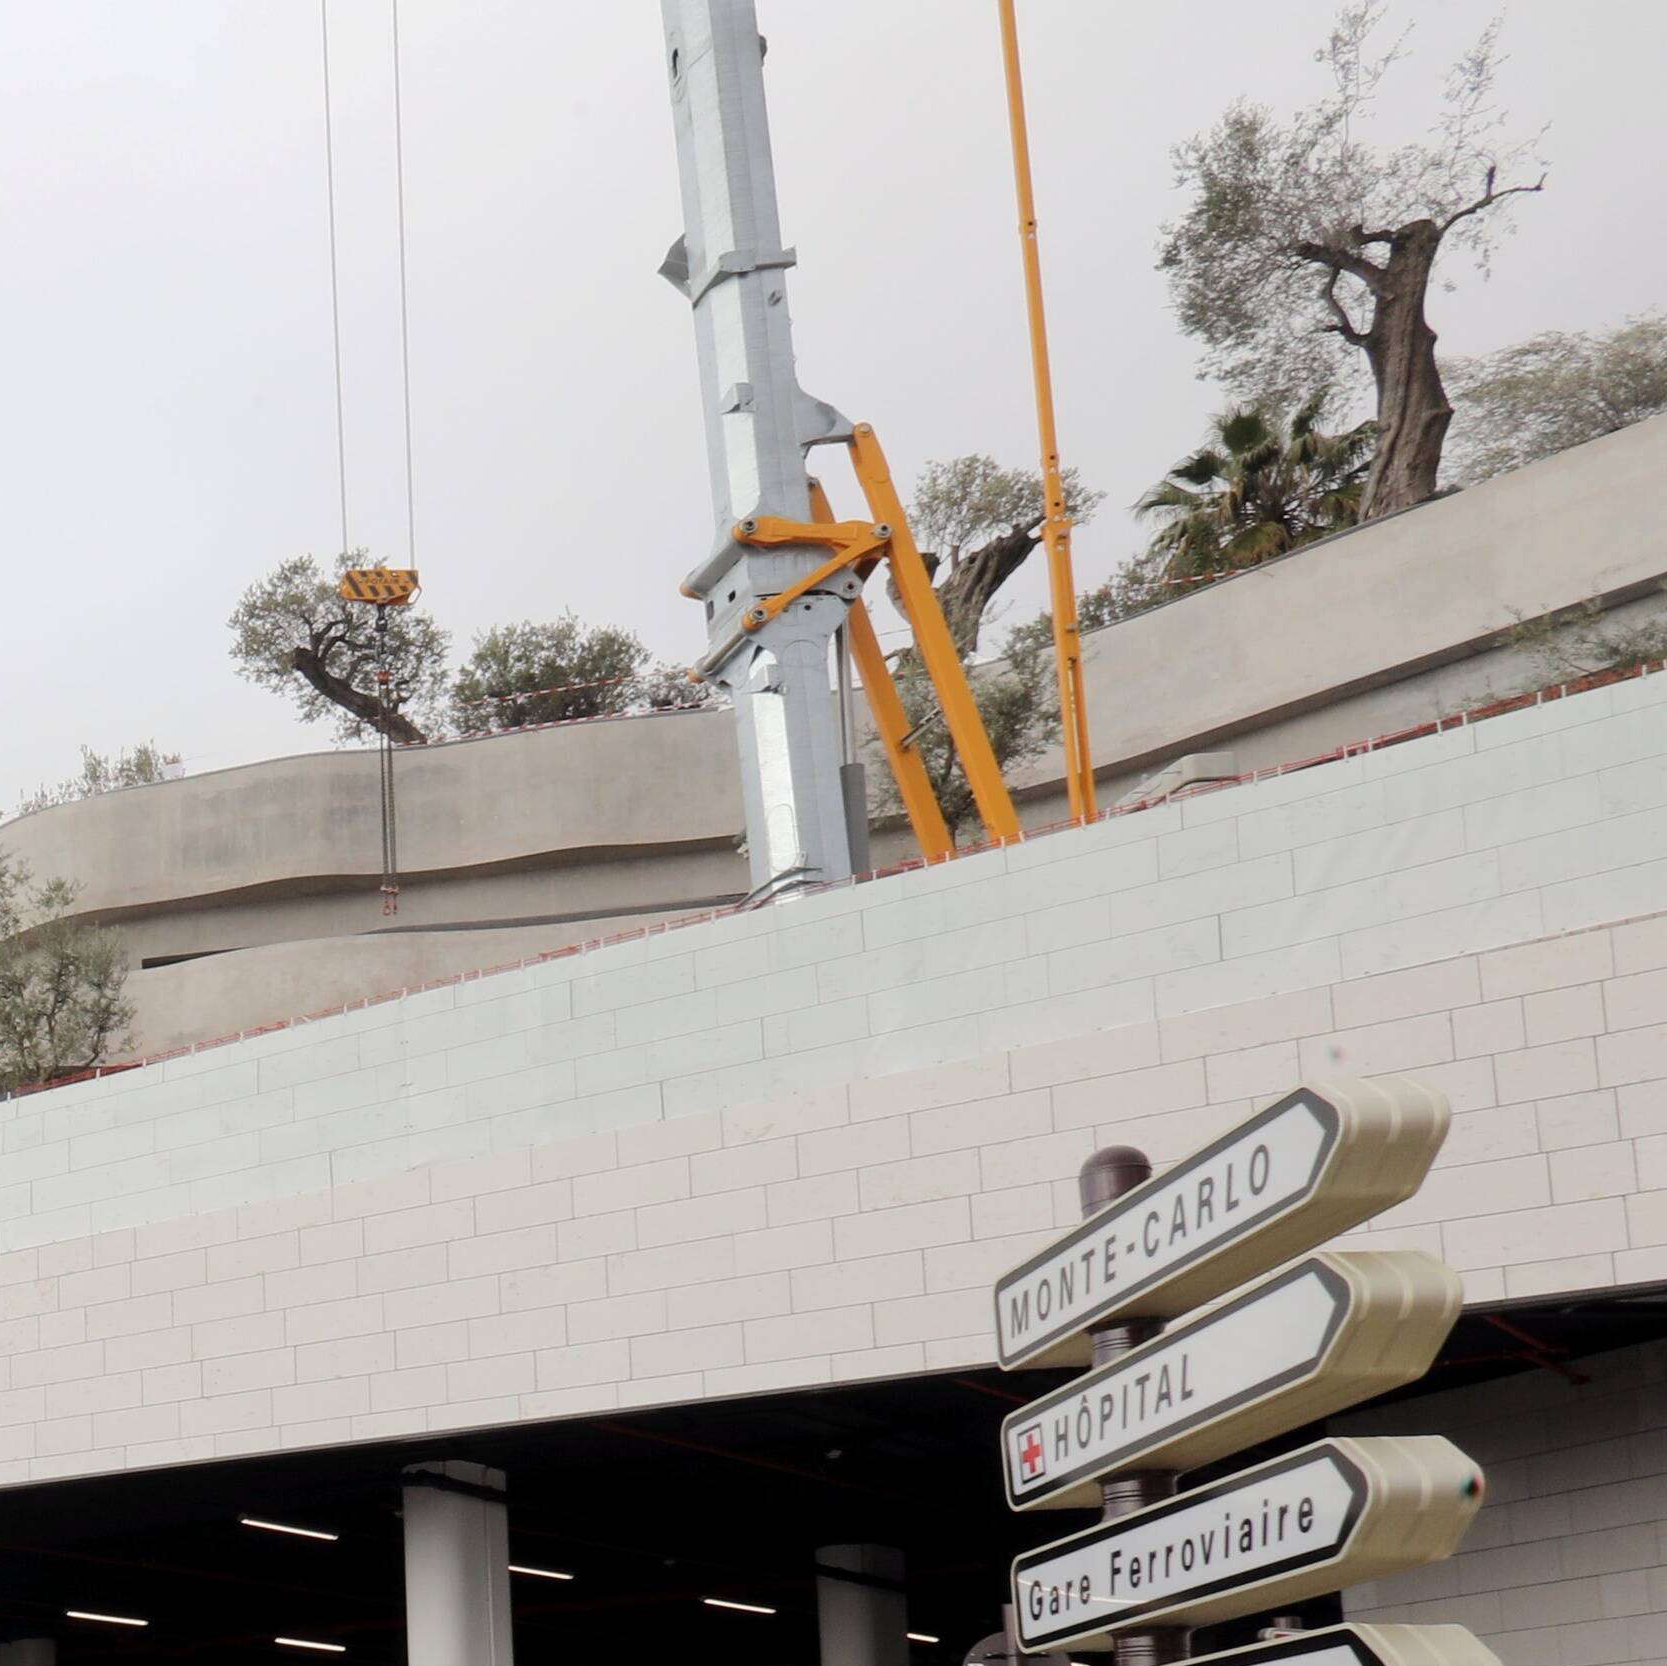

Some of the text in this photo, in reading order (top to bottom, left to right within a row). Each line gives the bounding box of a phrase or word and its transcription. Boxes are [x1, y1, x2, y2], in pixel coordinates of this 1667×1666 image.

[1010, 1143, 1271, 1339] MONTE-CARLO
[1054, 1353, 1195, 1462] HÔPITAL
[1029, 1496, 1315, 1622] Gare Ferroviaire
